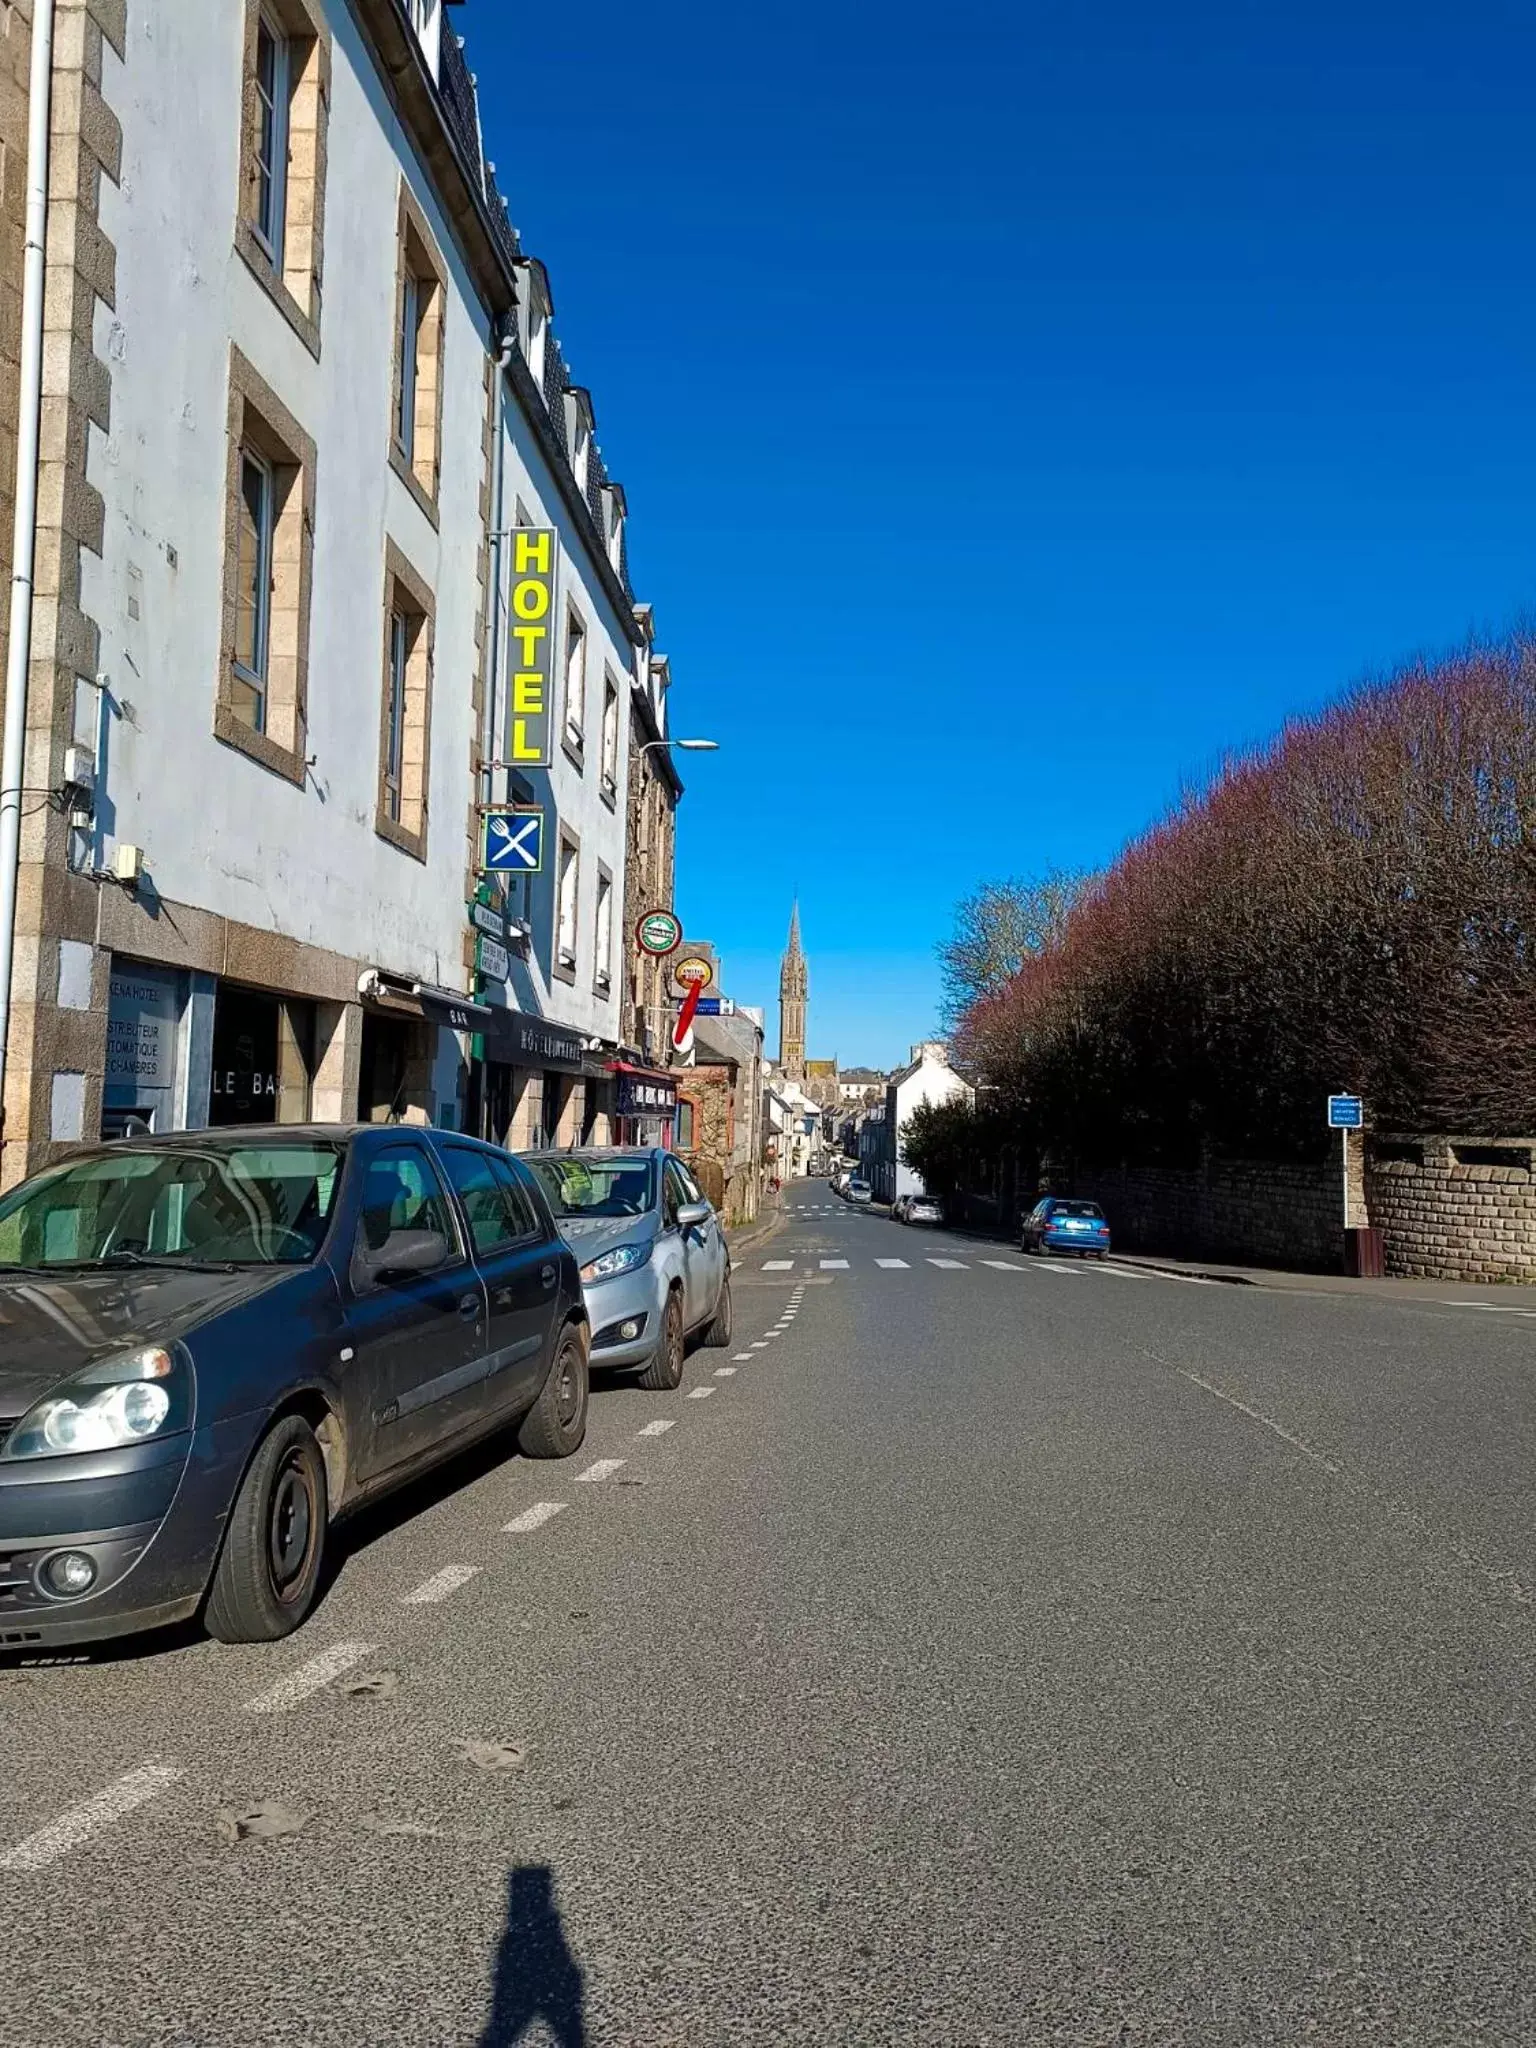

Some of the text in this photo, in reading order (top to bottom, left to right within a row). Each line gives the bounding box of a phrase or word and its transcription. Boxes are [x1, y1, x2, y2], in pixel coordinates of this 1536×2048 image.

[513, 533, 549, 759] HOTEL
[109, 982, 159, 1002] KENA HOTEL
[450, 1009, 469, 1027] BAR
[108, 1020, 159, 1039] STRIBUTEUR
[107, 1040, 159, 1057] TOMATIQUE
[110, 1059, 158, 1075] CHAMBRES
[213, 1070, 235, 1094] LE
